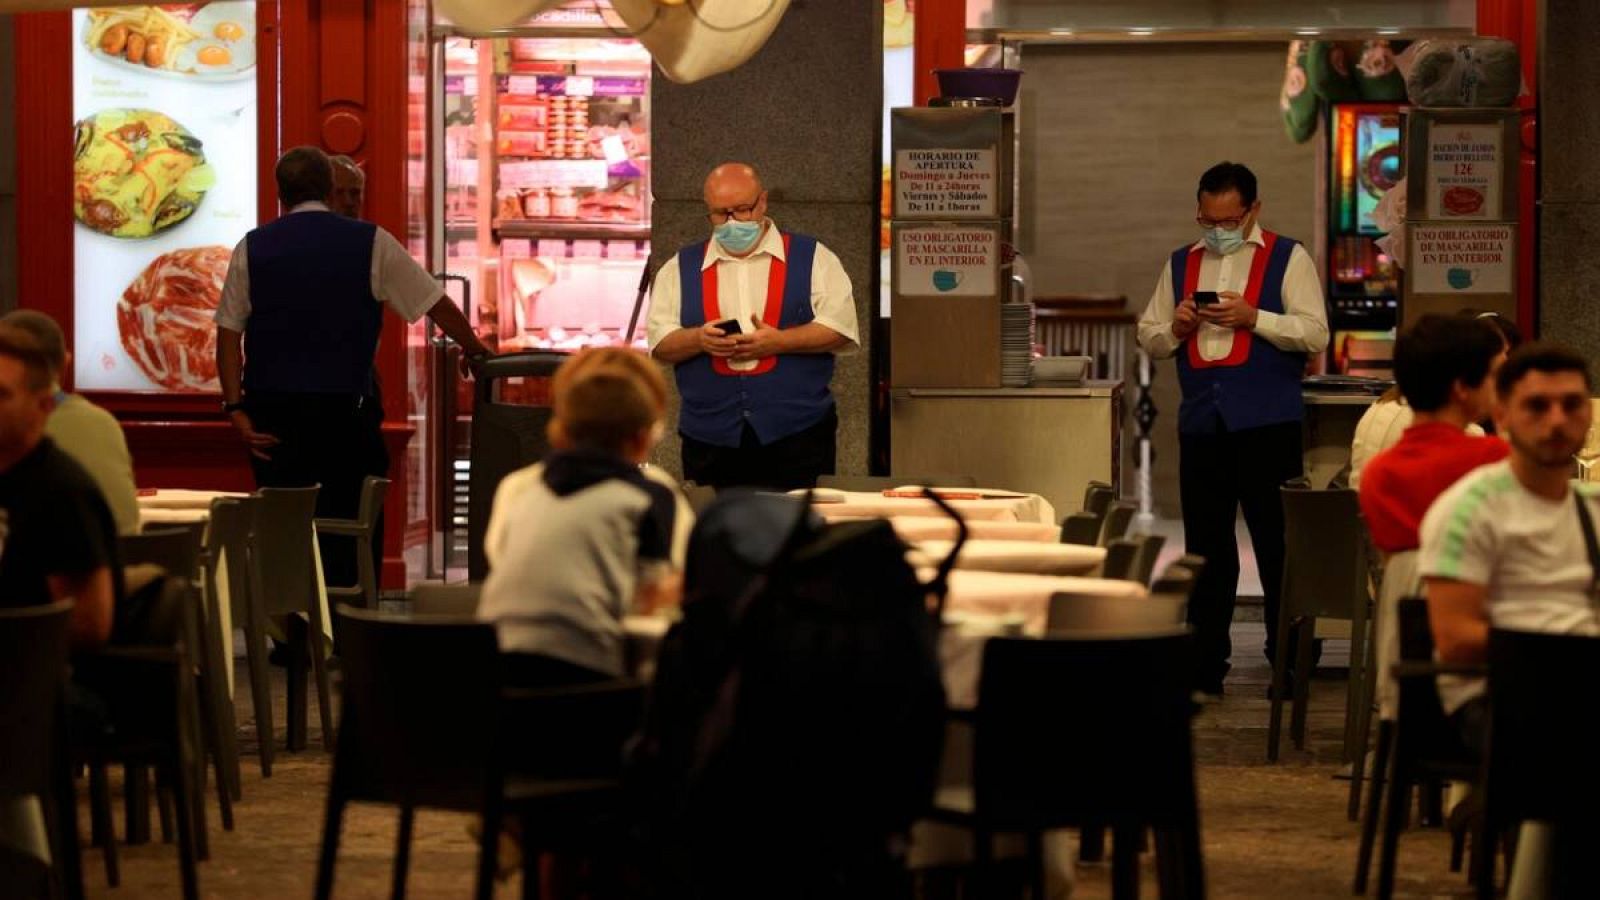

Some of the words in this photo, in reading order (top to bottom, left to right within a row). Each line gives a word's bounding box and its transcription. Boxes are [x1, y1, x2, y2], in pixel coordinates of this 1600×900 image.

[908, 152, 961, 160] HORARIO
[966, 152, 979, 160] DE
[916, 161, 974, 169] APERTURA
[1454, 163, 1473, 176] 12€
[900, 171, 945, 180] Domingo
[958, 171, 990, 180] Jueves
[910, 182, 923, 190] De
[926, 182, 934, 190] 11
[903, 192, 938, 200] Viernes
[940, 194, 945, 202] y
[908, 203, 921, 211] De
[926, 203, 934, 211] 11
[903, 233, 921, 242] USO
[924, 232, 992, 242] OBLIGATORIO
[1416, 231, 1436, 240] USO
[1438, 230, 1508, 240] OBLIGATORIO
[907, 244, 918, 253] DE
[922, 244, 987, 254] MASCARILLA
[1420, 242, 1434, 252] DE
[1437, 242, 1503, 252] MASCARILLA
[909, 256, 921, 265] EN
[924, 256, 937, 265] EL
[939, 256, 986, 265] INTERIOR
[1423, 254, 1436, 264] EN
[1439, 254, 1451, 264] EL
[1453, 253, 1503, 264] INTERIOR
